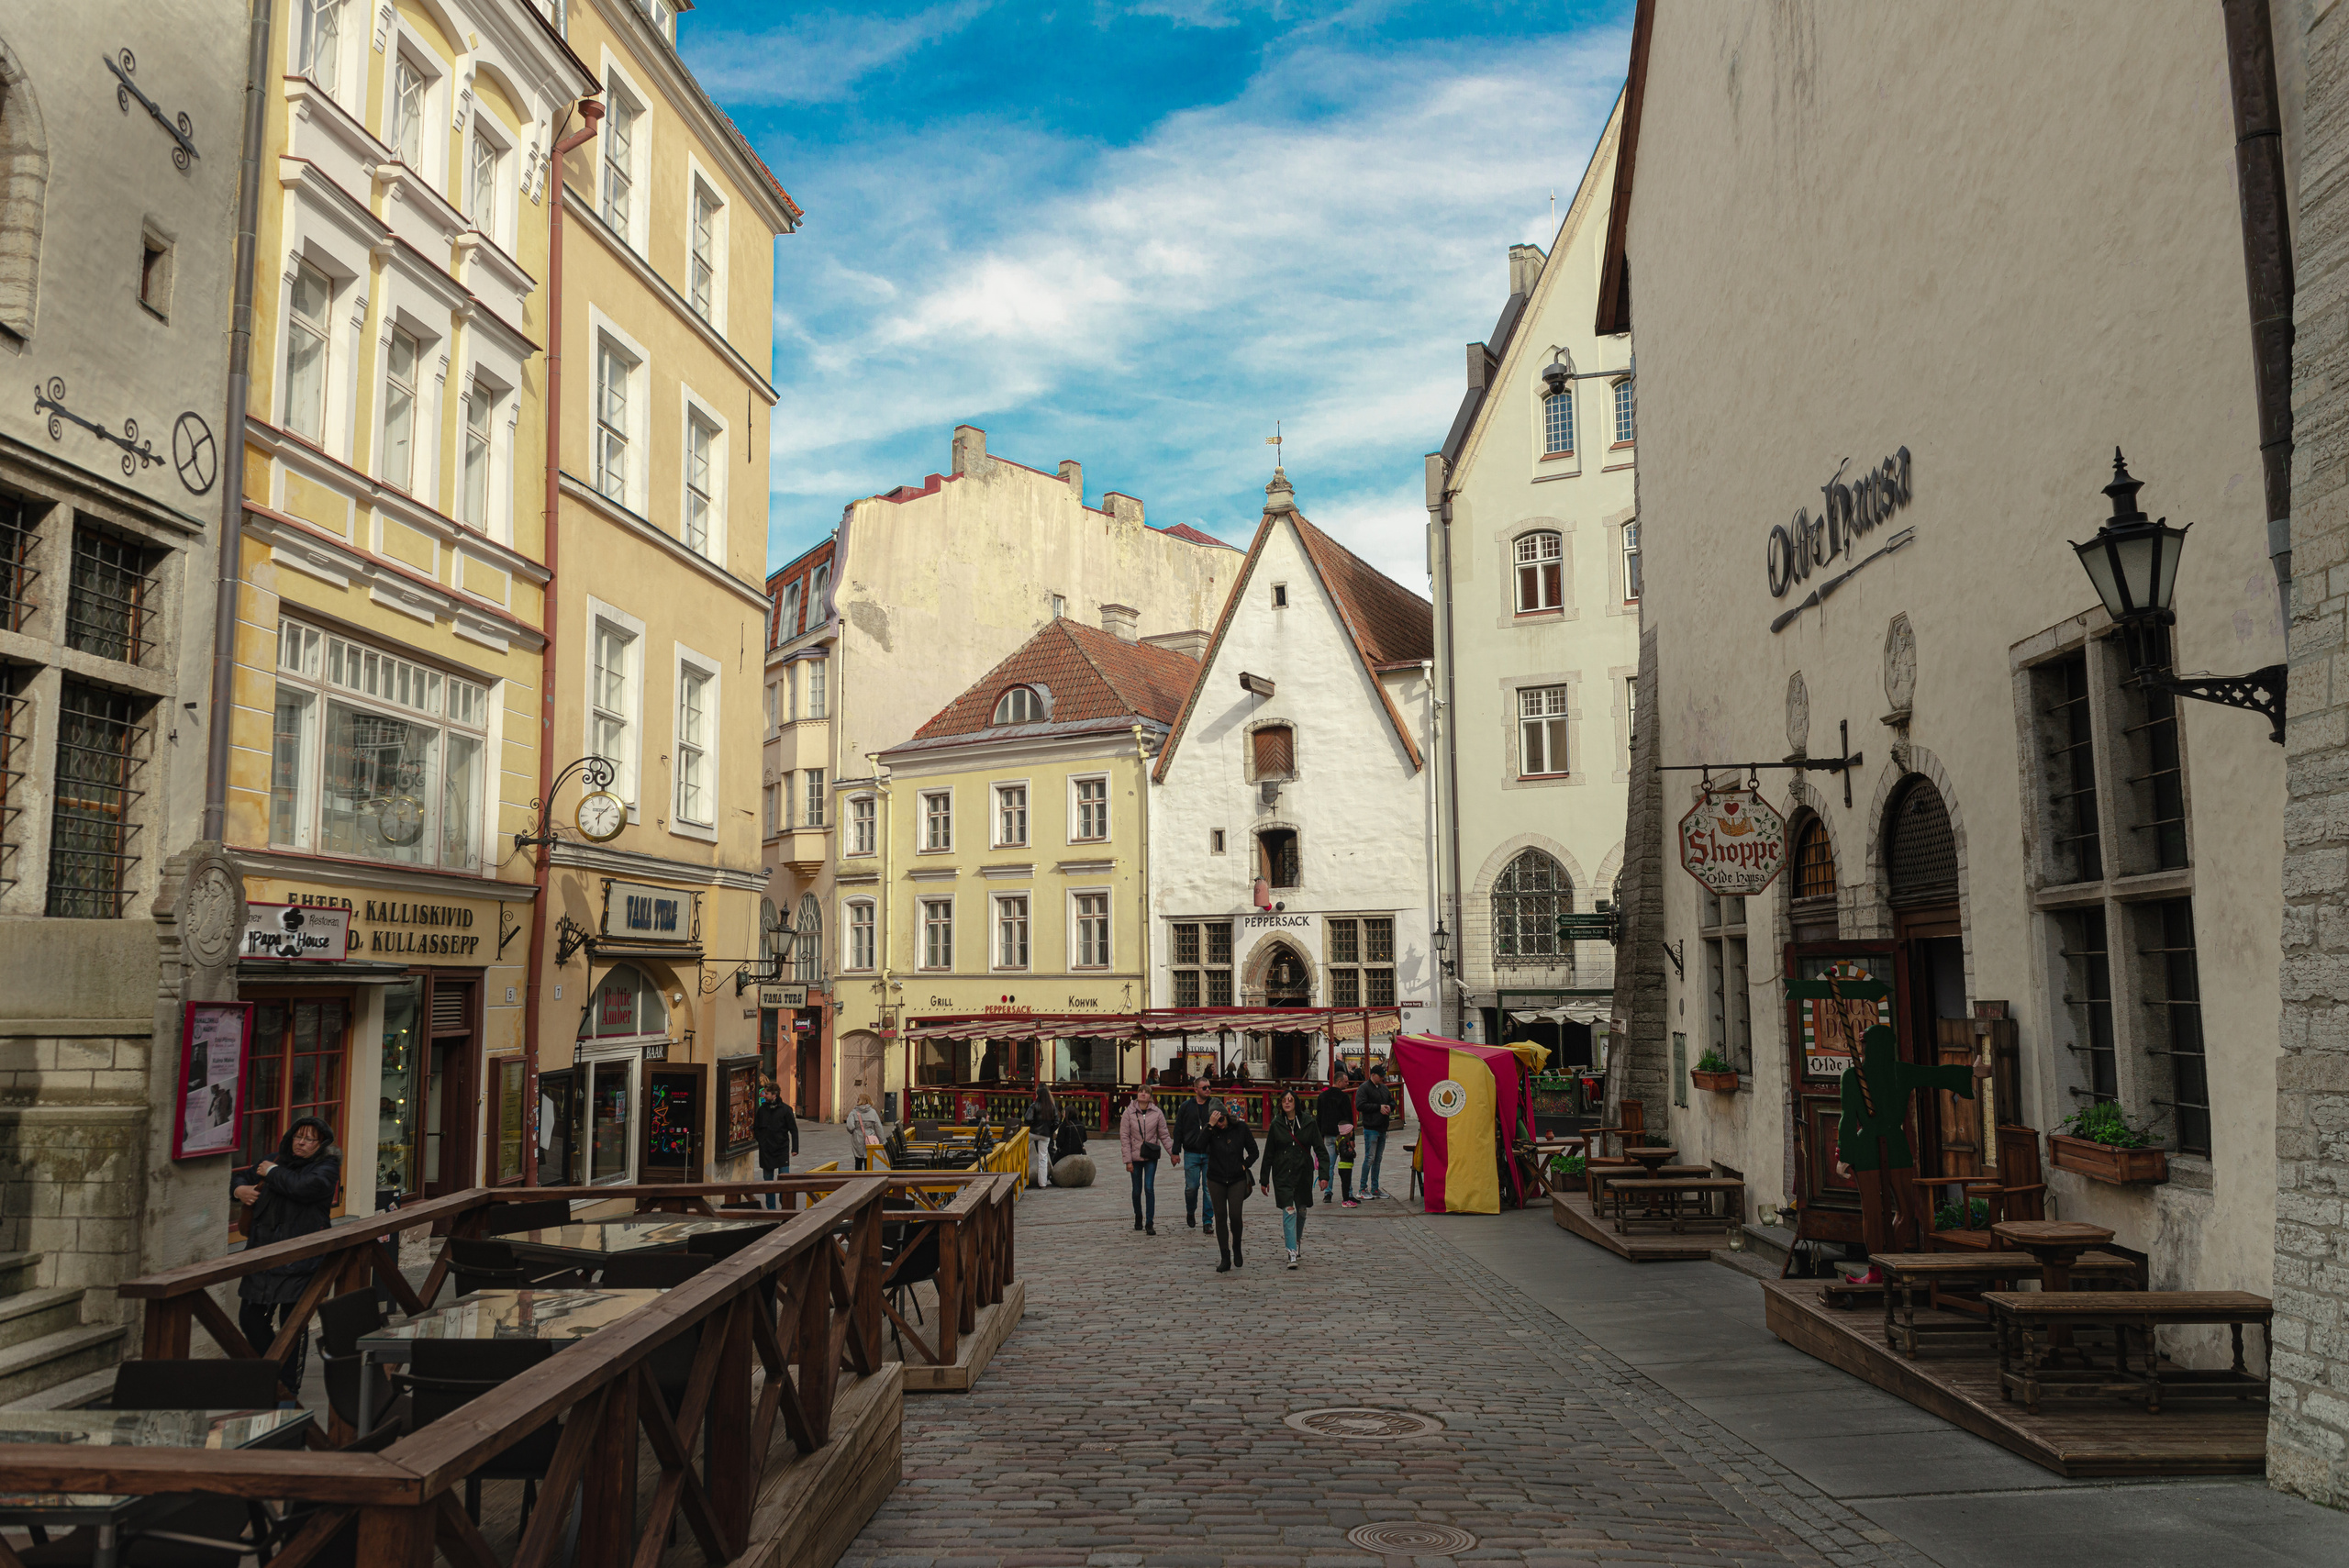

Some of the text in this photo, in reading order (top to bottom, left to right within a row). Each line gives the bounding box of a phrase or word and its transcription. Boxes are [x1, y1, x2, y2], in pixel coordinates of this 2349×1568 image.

[1706, 869, 1732, 884] Olde
[309, 915, 340, 927] Restoran
[365, 899, 473, 928] KALLISKIVID
[1244, 916, 1310, 928] PEPPERSACK
[296, 932, 330, 948] House
[372, 930, 479, 955] KULLASSEPP
[507, 990, 513, 1000] 5
[557, 987, 562, 997] 7
[604, 986, 632, 1006] Baltic
[763, 993, 803, 1004] VANA TURG
[1068, 995, 1098, 1007] KOHVIK
[601, 1007, 632, 1026] Amber
[985, 1006, 1032, 1014] PEPPERSACK
[645, 1045, 663, 1060] BAAR
[1809, 1057, 1842, 1072] Olde
